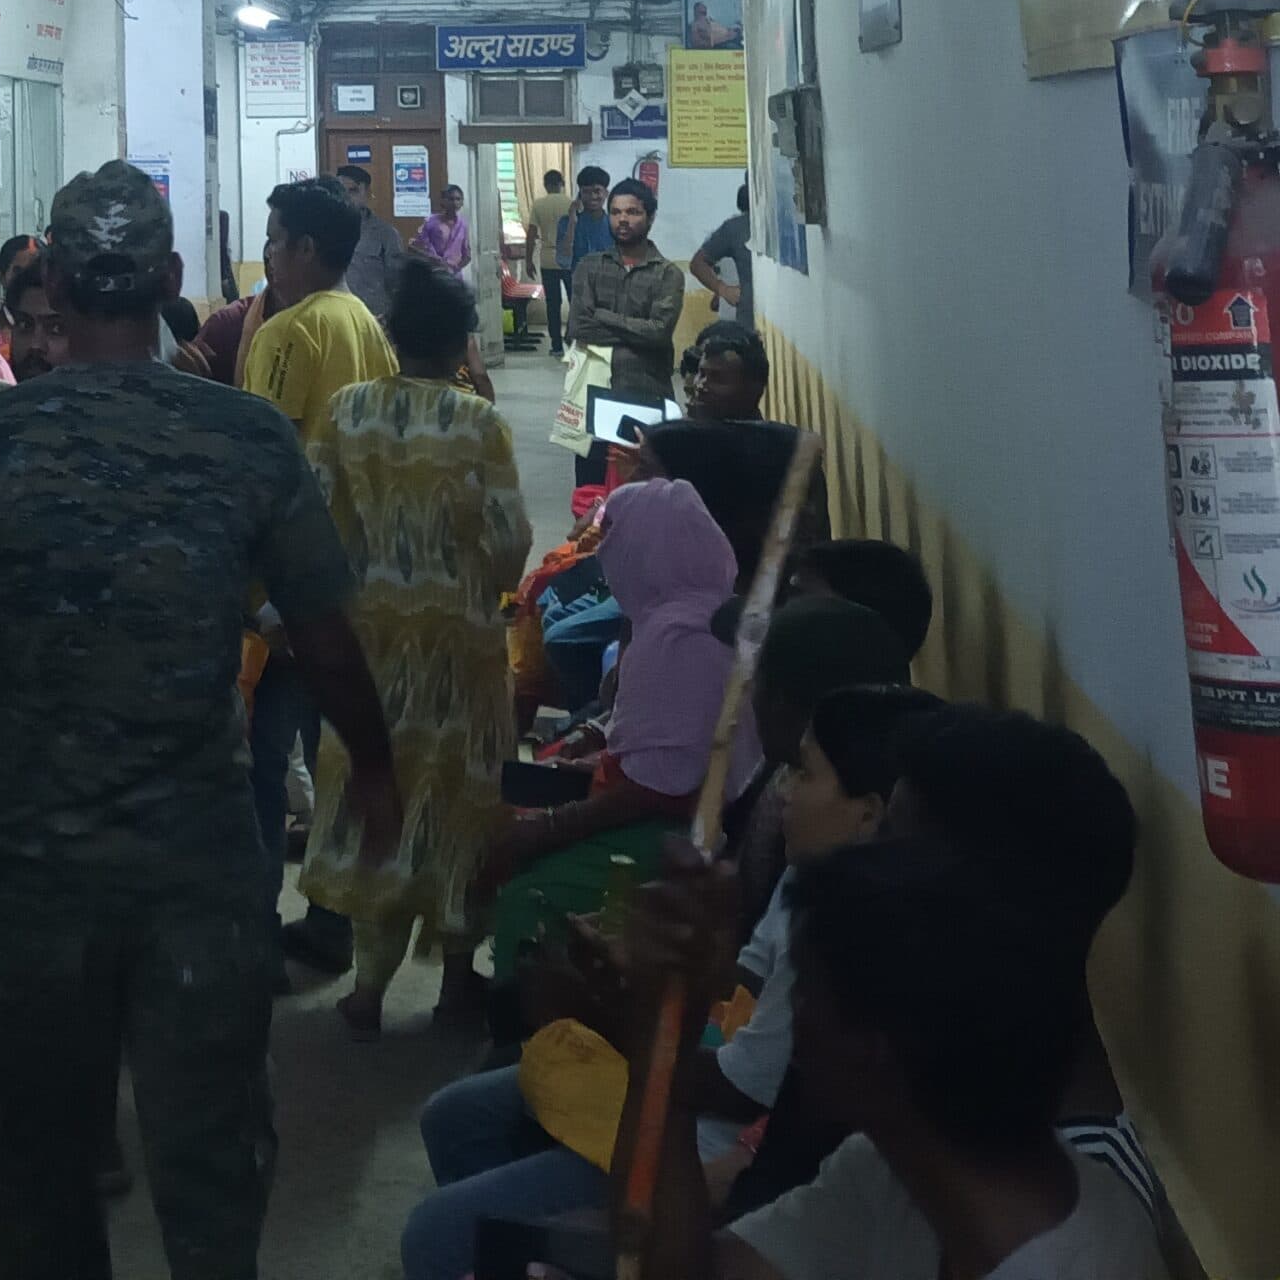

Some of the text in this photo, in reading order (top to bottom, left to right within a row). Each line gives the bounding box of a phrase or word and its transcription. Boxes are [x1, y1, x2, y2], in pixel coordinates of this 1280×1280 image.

[443, 33, 577, 65] अल्ट्रा साउण्ड
[1180, 352, 1262, 372] DIOXIDE
[1216, 687, 1248, 702] PVT
